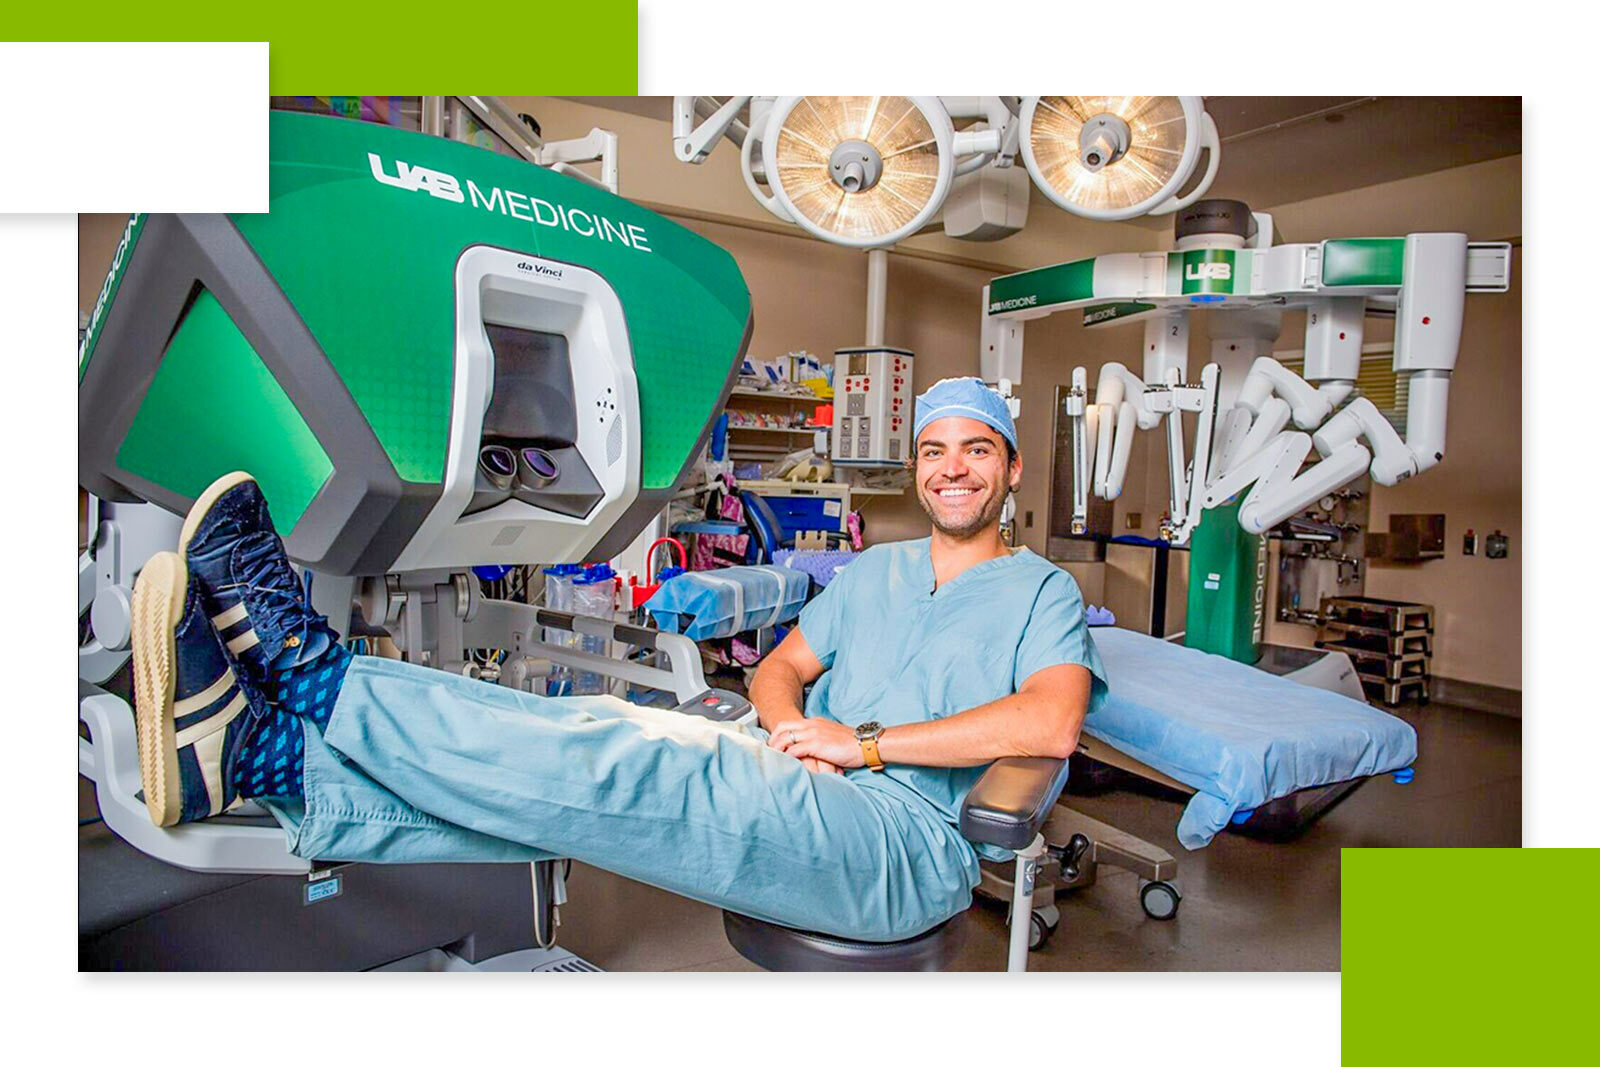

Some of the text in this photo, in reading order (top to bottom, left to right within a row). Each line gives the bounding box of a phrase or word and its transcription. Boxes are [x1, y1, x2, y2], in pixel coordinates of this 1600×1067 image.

[368, 152, 652, 253] UAB MEDICINE
[517, 262, 533, 271] da
[535, 264, 563, 277] Vinci
[1186, 262, 1231, 281] UAB
[1311, 313, 1318, 325] 3
[1172, 326, 1178, 336] 2
